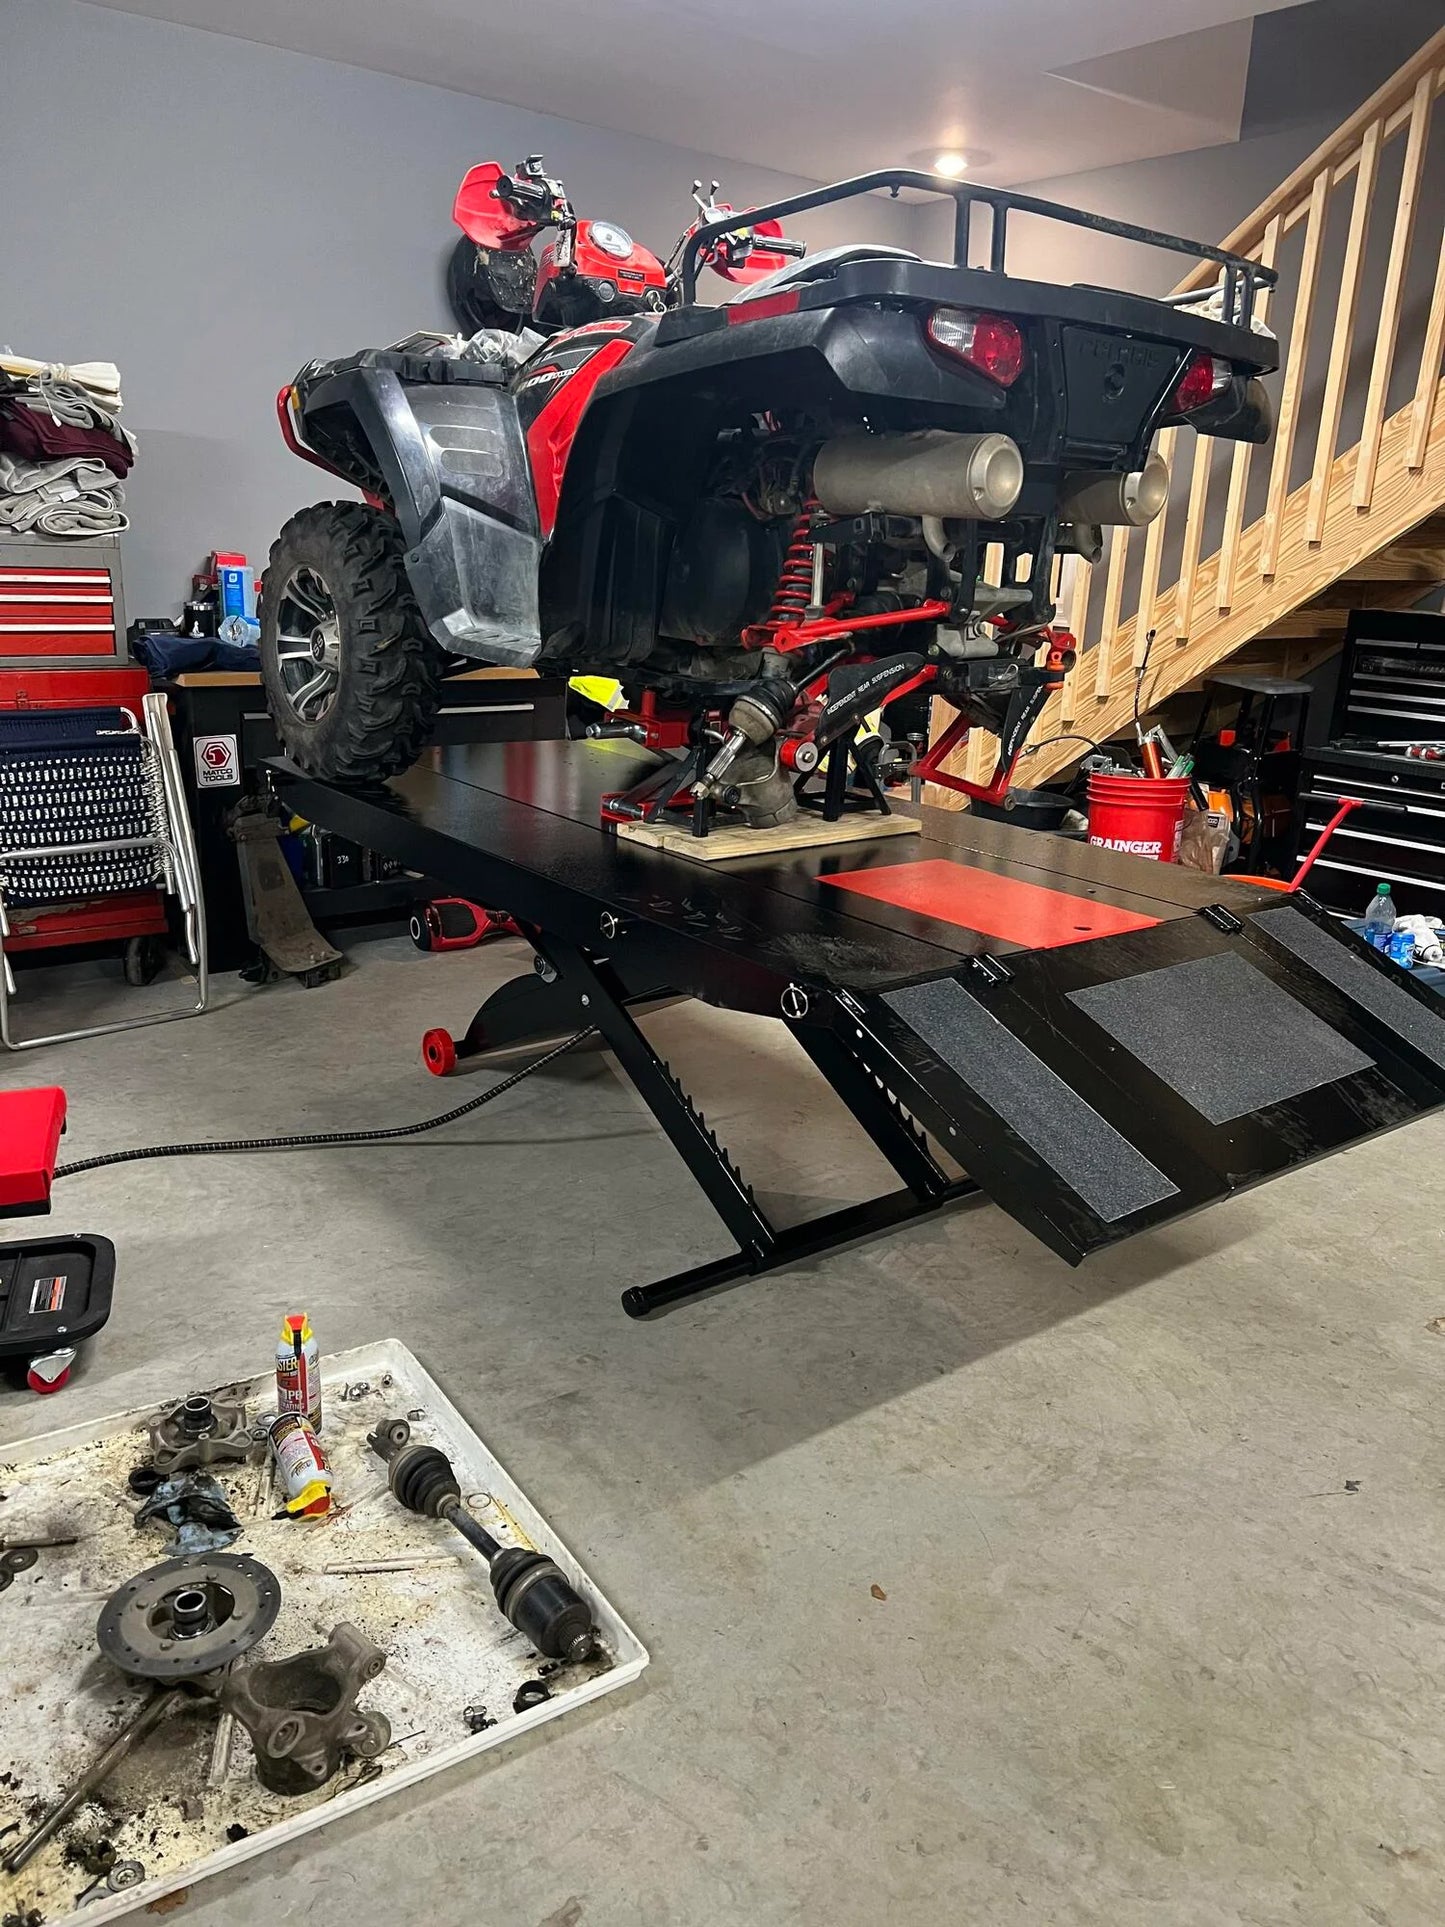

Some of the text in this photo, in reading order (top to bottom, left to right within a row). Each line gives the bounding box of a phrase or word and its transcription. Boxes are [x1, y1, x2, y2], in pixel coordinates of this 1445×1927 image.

[857, 681, 871, 693] REAR
[871, 663, 905, 684] SUSPENSION
[1020, 705, 1031, 720] REAR
[203, 768, 233, 776] MATCO
[203, 774, 234, 782] TOOLS
[1090, 835, 1162, 854] GRAINGER
